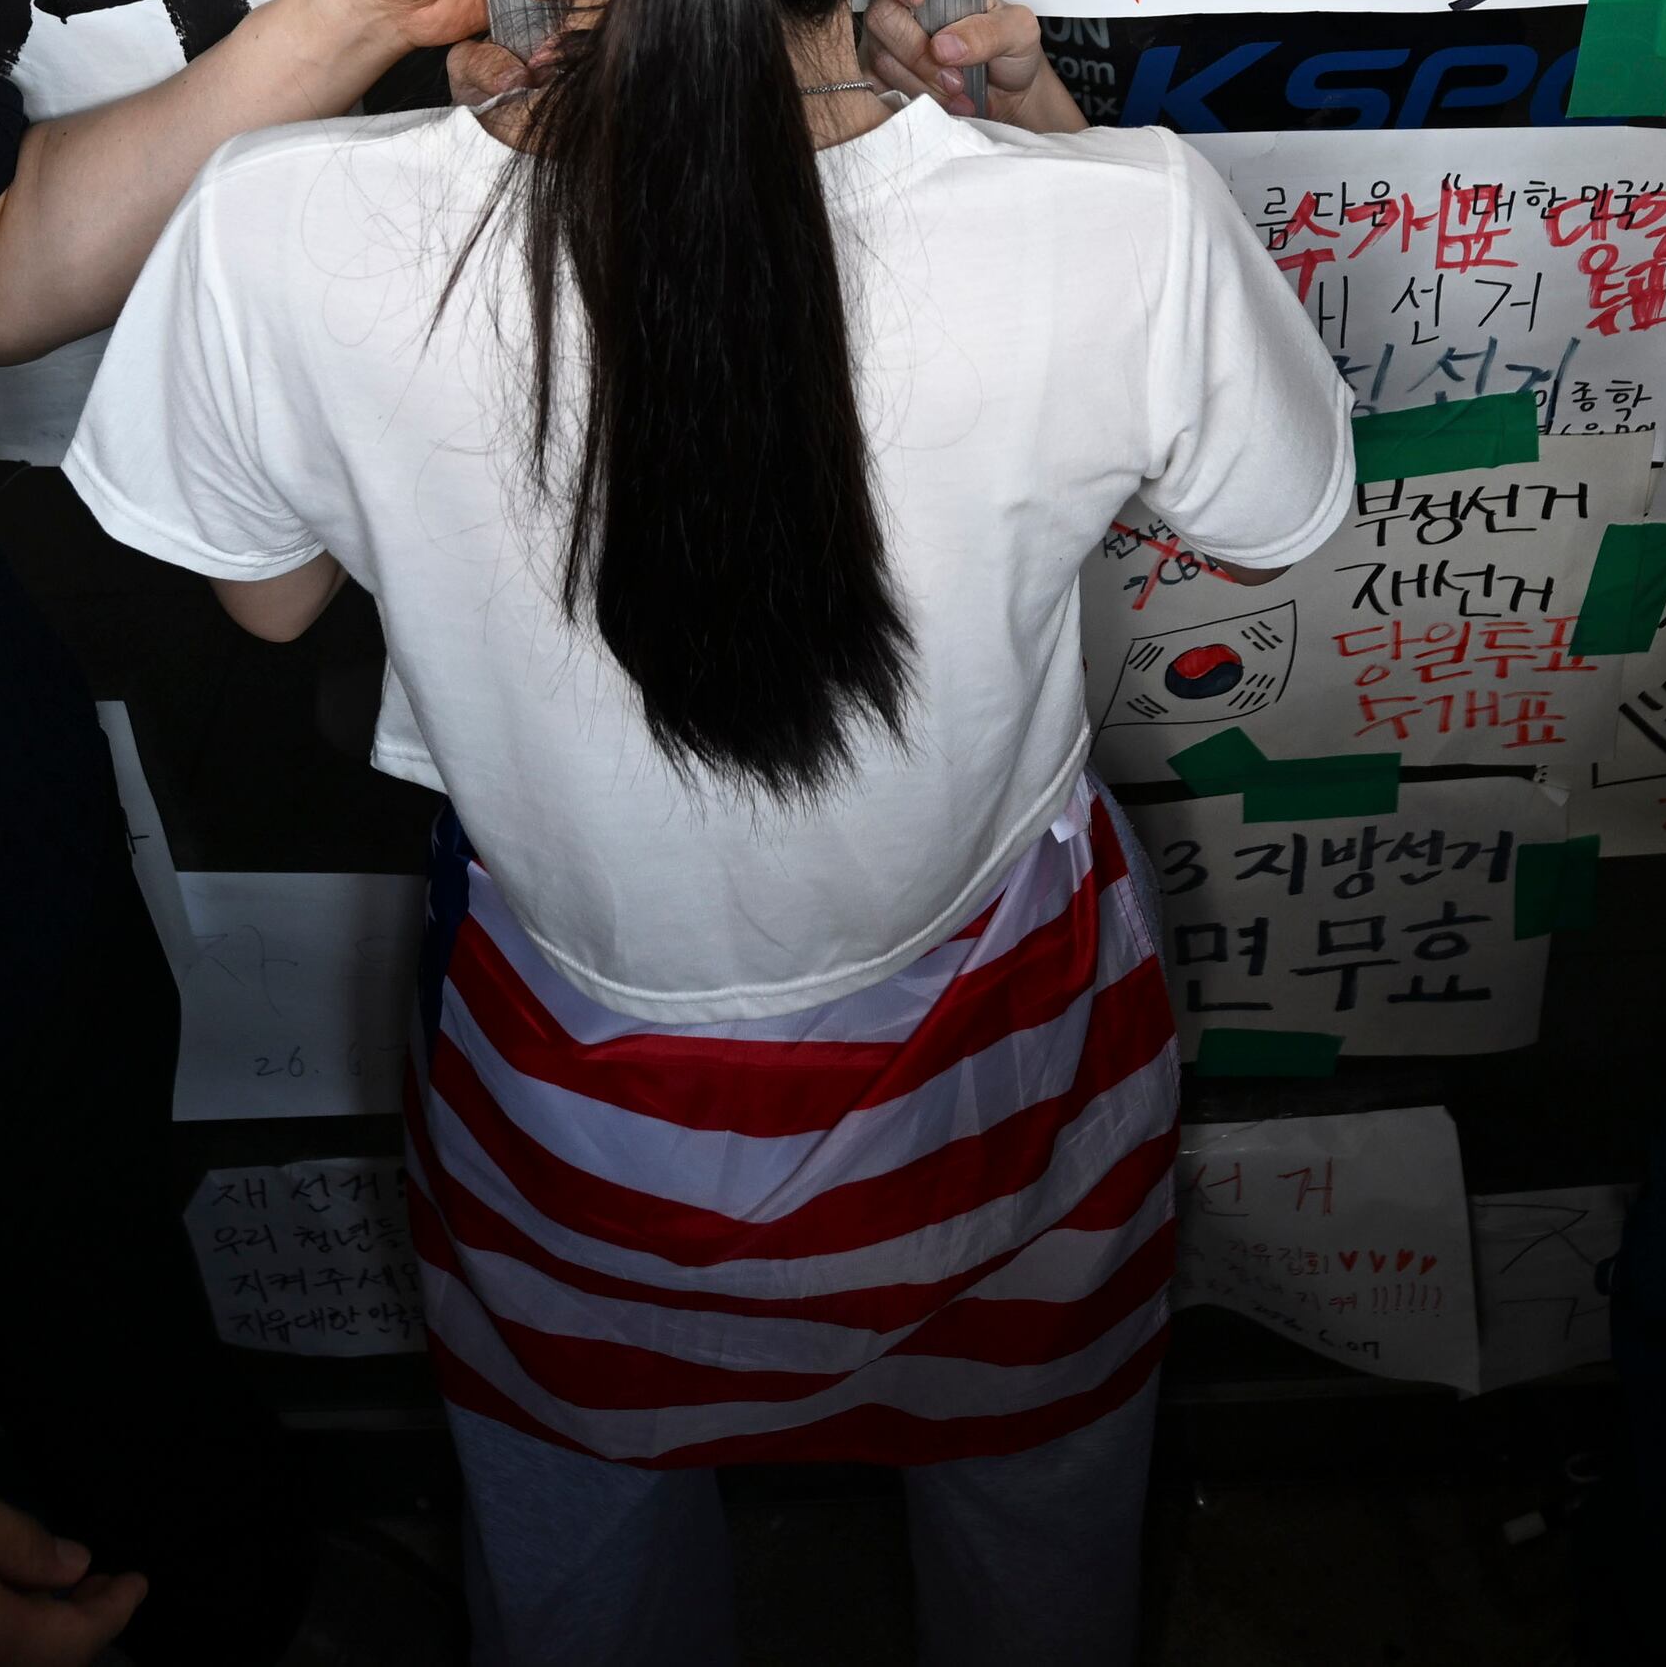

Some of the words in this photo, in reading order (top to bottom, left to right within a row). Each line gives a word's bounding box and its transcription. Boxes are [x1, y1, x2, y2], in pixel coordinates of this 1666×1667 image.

[1244, 179, 1392, 251] 름다운
[1354, 478, 1589, 547] 부정선거
[1335, 560, 1554, 617] 재선거
[1332, 615, 1597, 686] 당일투표
[1234, 825, 1513, 900] 지방선거
[1290, 901, 1493, 1012] 무효
[213, 1223, 278, 1254] 우리
